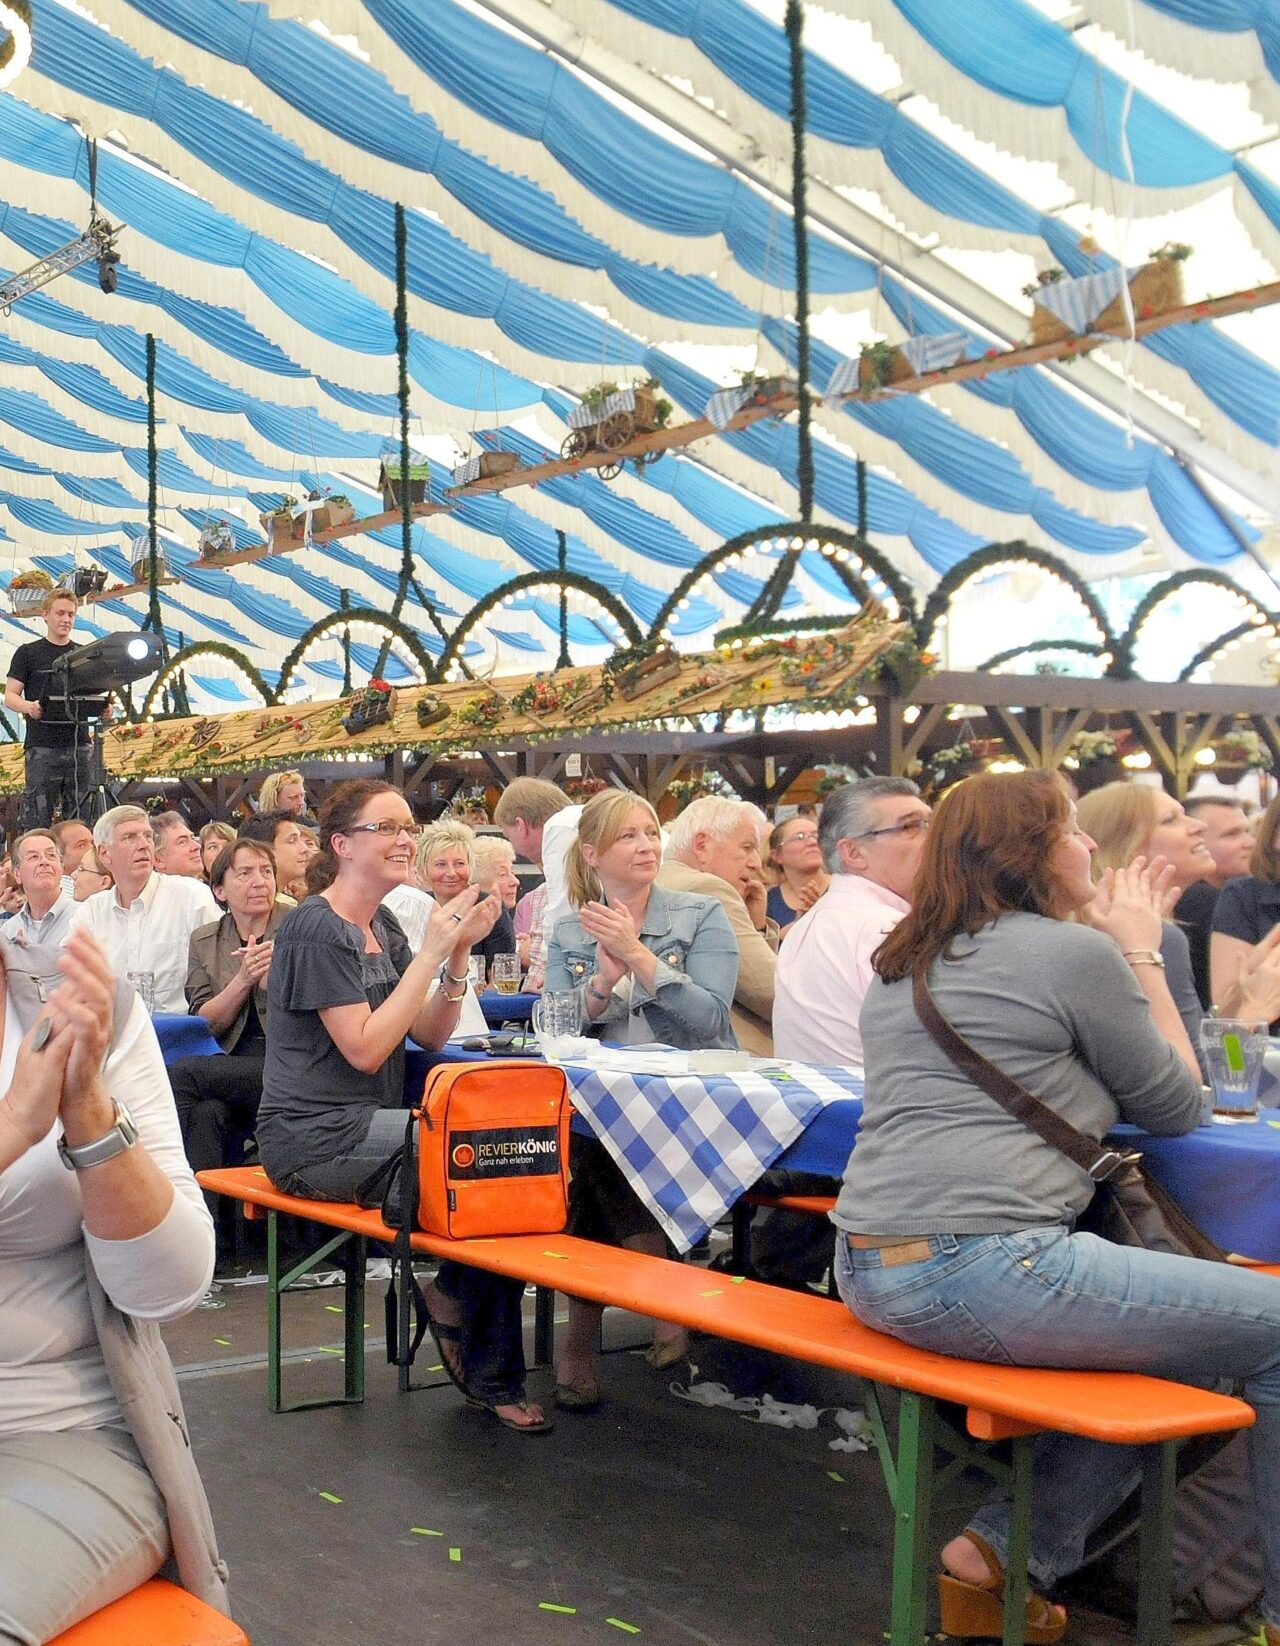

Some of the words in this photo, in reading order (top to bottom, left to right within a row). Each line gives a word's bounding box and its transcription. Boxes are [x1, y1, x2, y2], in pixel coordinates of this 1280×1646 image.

[478, 1139, 557, 1156] REVIERKÖNIG
[478, 1158, 495, 1166] Ganz
[509, 1156, 534, 1164] erleben
